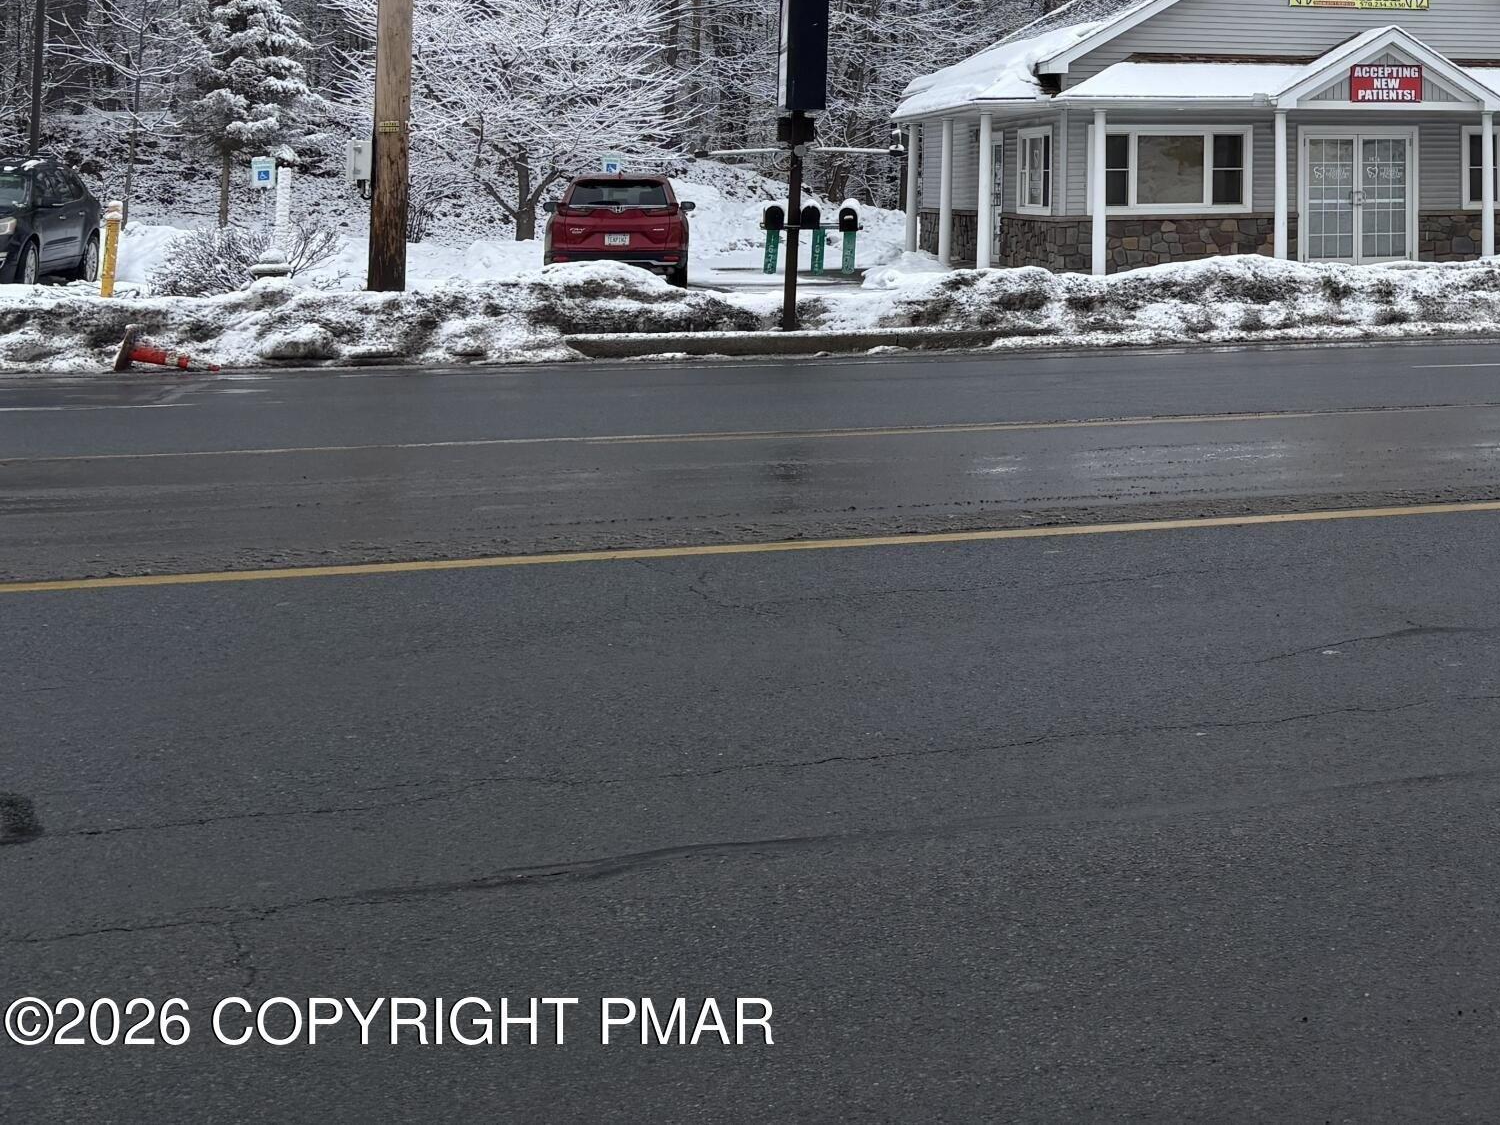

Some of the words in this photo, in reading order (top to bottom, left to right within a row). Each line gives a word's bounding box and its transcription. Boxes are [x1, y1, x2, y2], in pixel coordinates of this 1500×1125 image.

[1354, 66, 1419, 78] ACCEPTING
[1373, 78, 1400, 89] NEW
[1358, 89, 1416, 100] PATIENTS!
